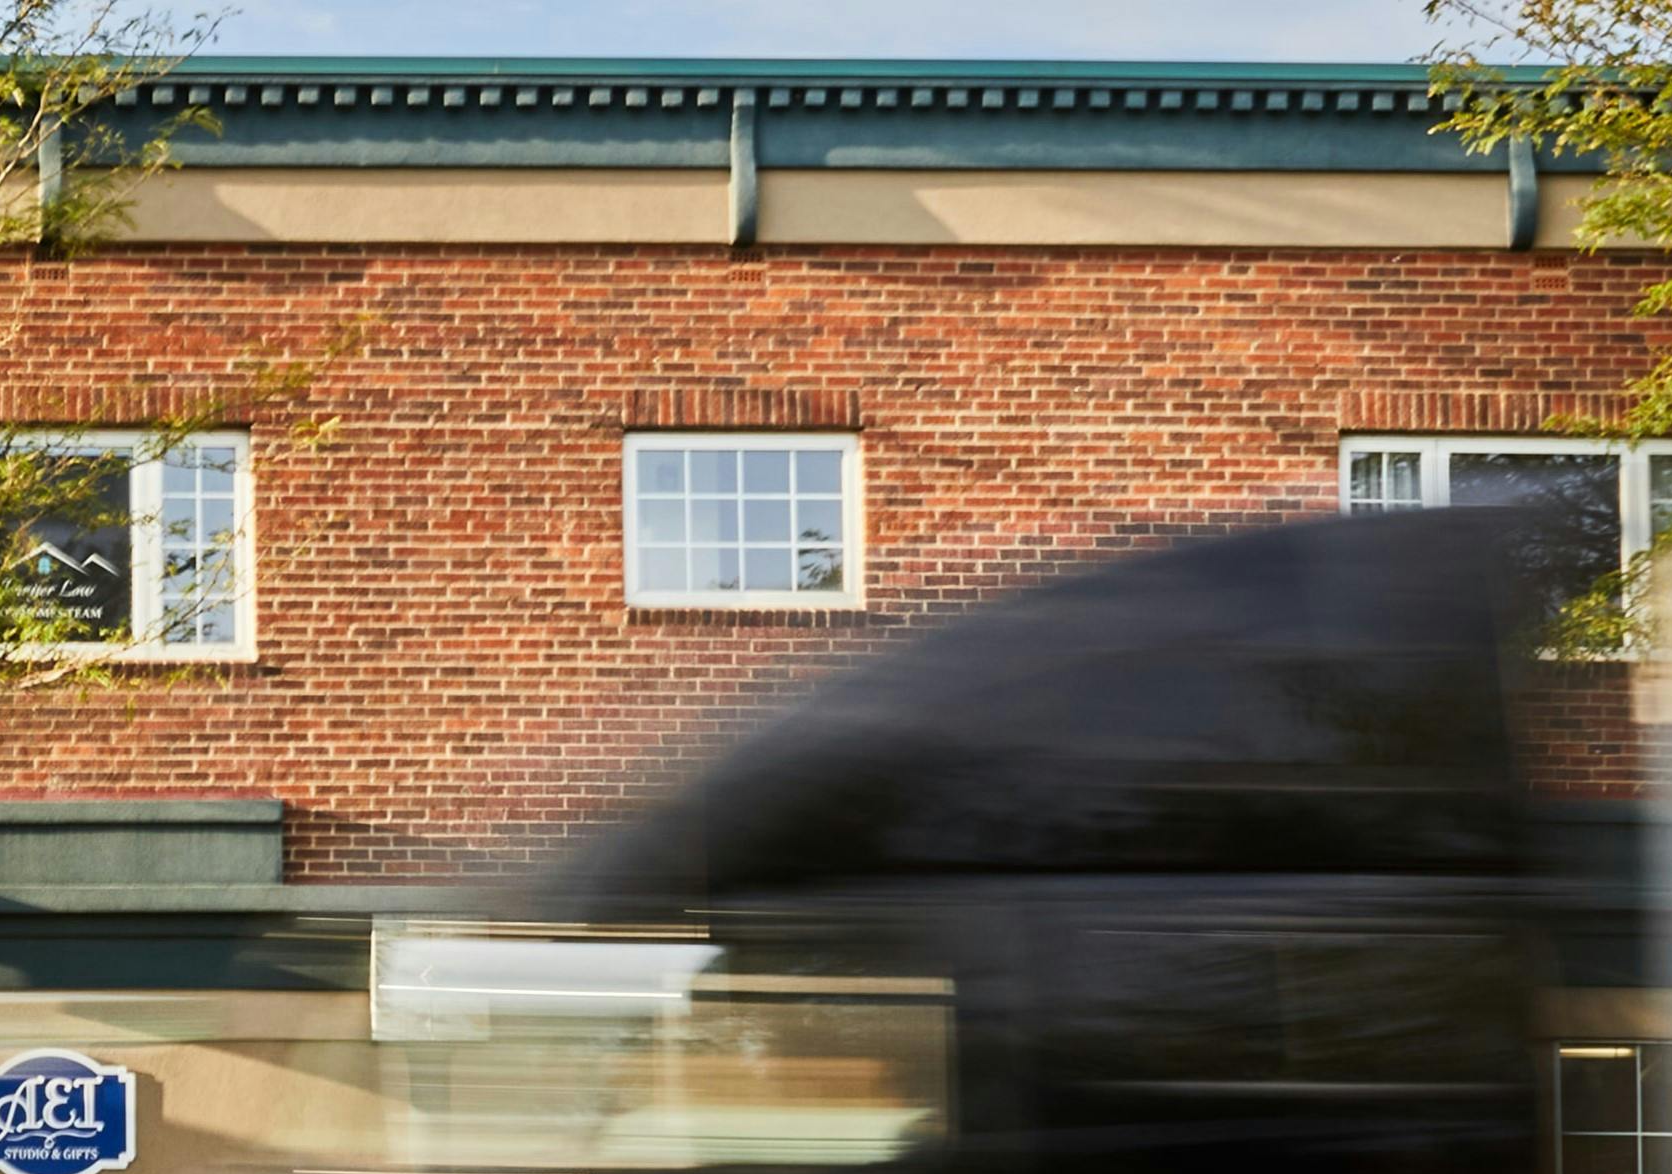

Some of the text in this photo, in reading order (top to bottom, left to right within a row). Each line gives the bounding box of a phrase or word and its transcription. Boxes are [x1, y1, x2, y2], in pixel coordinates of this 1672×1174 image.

[66, 605, 104, 619] TEAM
[4, 1146, 99, 1160] STUDIO & GIFTS
